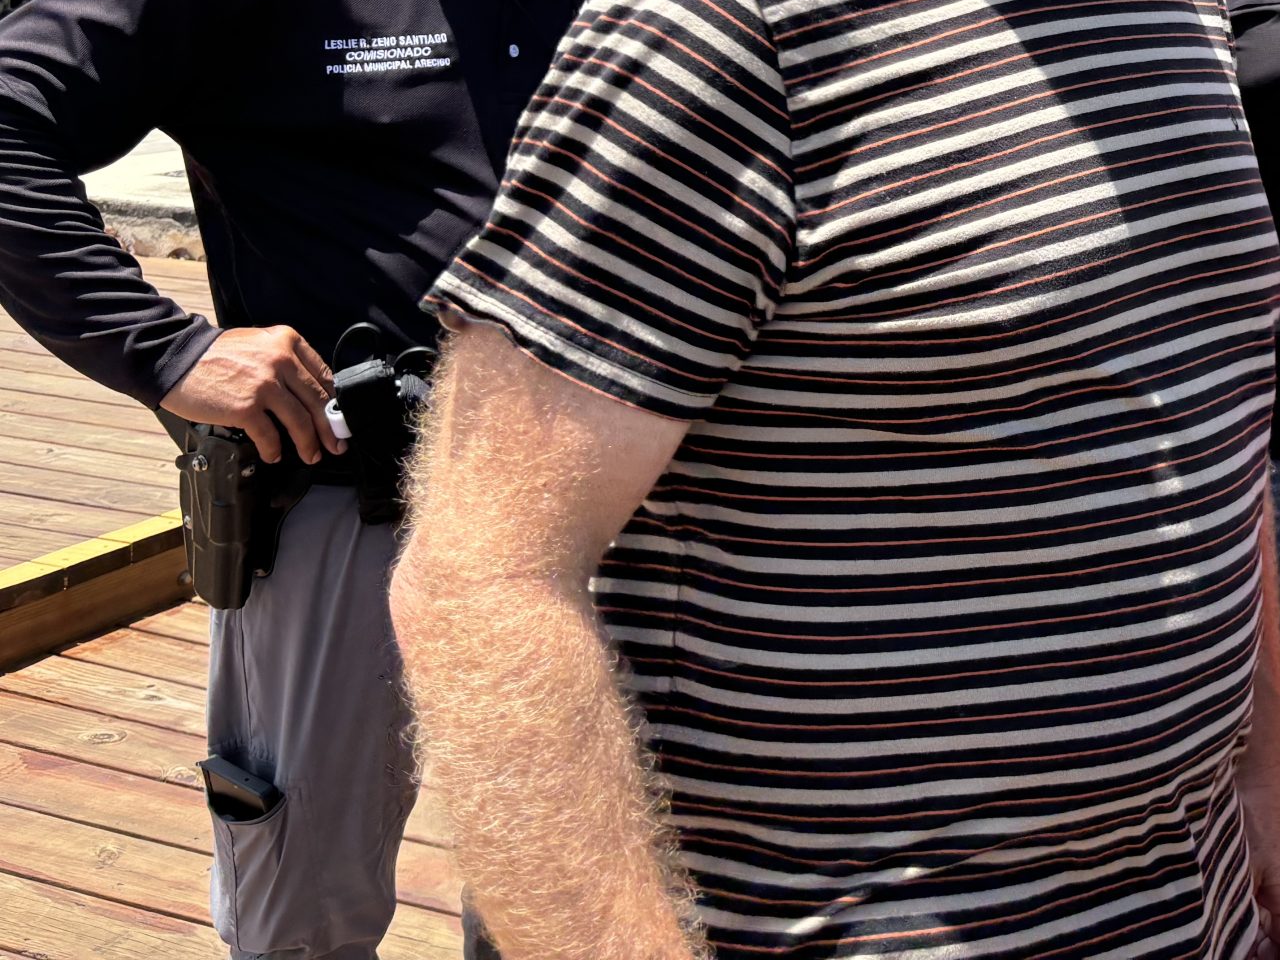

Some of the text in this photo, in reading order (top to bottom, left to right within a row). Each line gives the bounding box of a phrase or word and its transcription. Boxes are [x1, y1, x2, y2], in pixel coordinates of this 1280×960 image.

[324, 38, 358, 50] LESLIE
[372, 36, 397, 47] ZENO
[399, 33, 448, 46] SANTIAGO
[345, 46, 432, 61] COMISIONADO
[326, 62, 362, 75] POLICIA
[364, 59, 413, 73] MUNICIPAL
